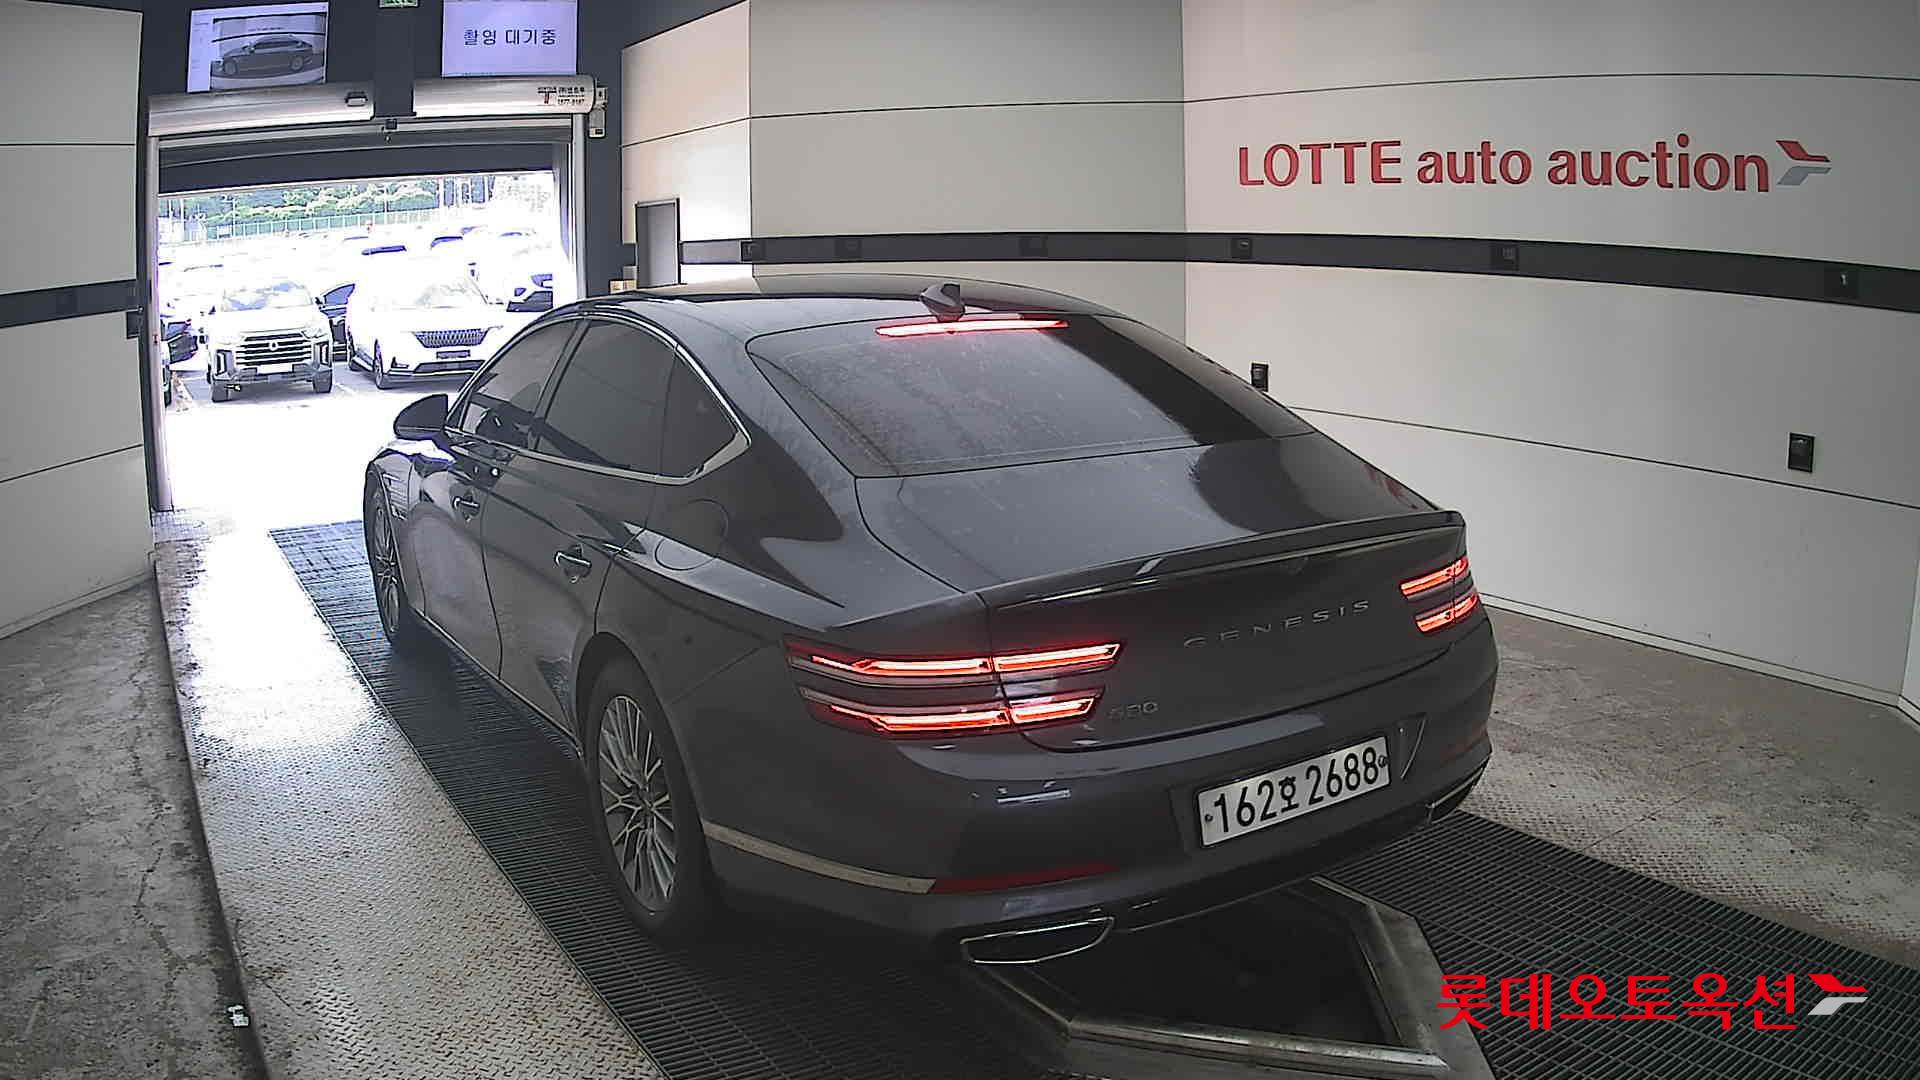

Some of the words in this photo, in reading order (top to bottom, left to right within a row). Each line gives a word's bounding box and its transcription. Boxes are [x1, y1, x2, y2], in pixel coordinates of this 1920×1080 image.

[464, 29, 496, 45] 촬영
[505, 29, 556, 45] 대기중
[1238, 140, 1401, 186] LOTTE
[1416, 140, 1532, 185] auto
[1547, 133, 1769, 193] auction
[1183, 600, 1369, 649] GENESIS
[1213, 776, 1299, 833] 162호
[1306, 746, 1379, 805] 2688
